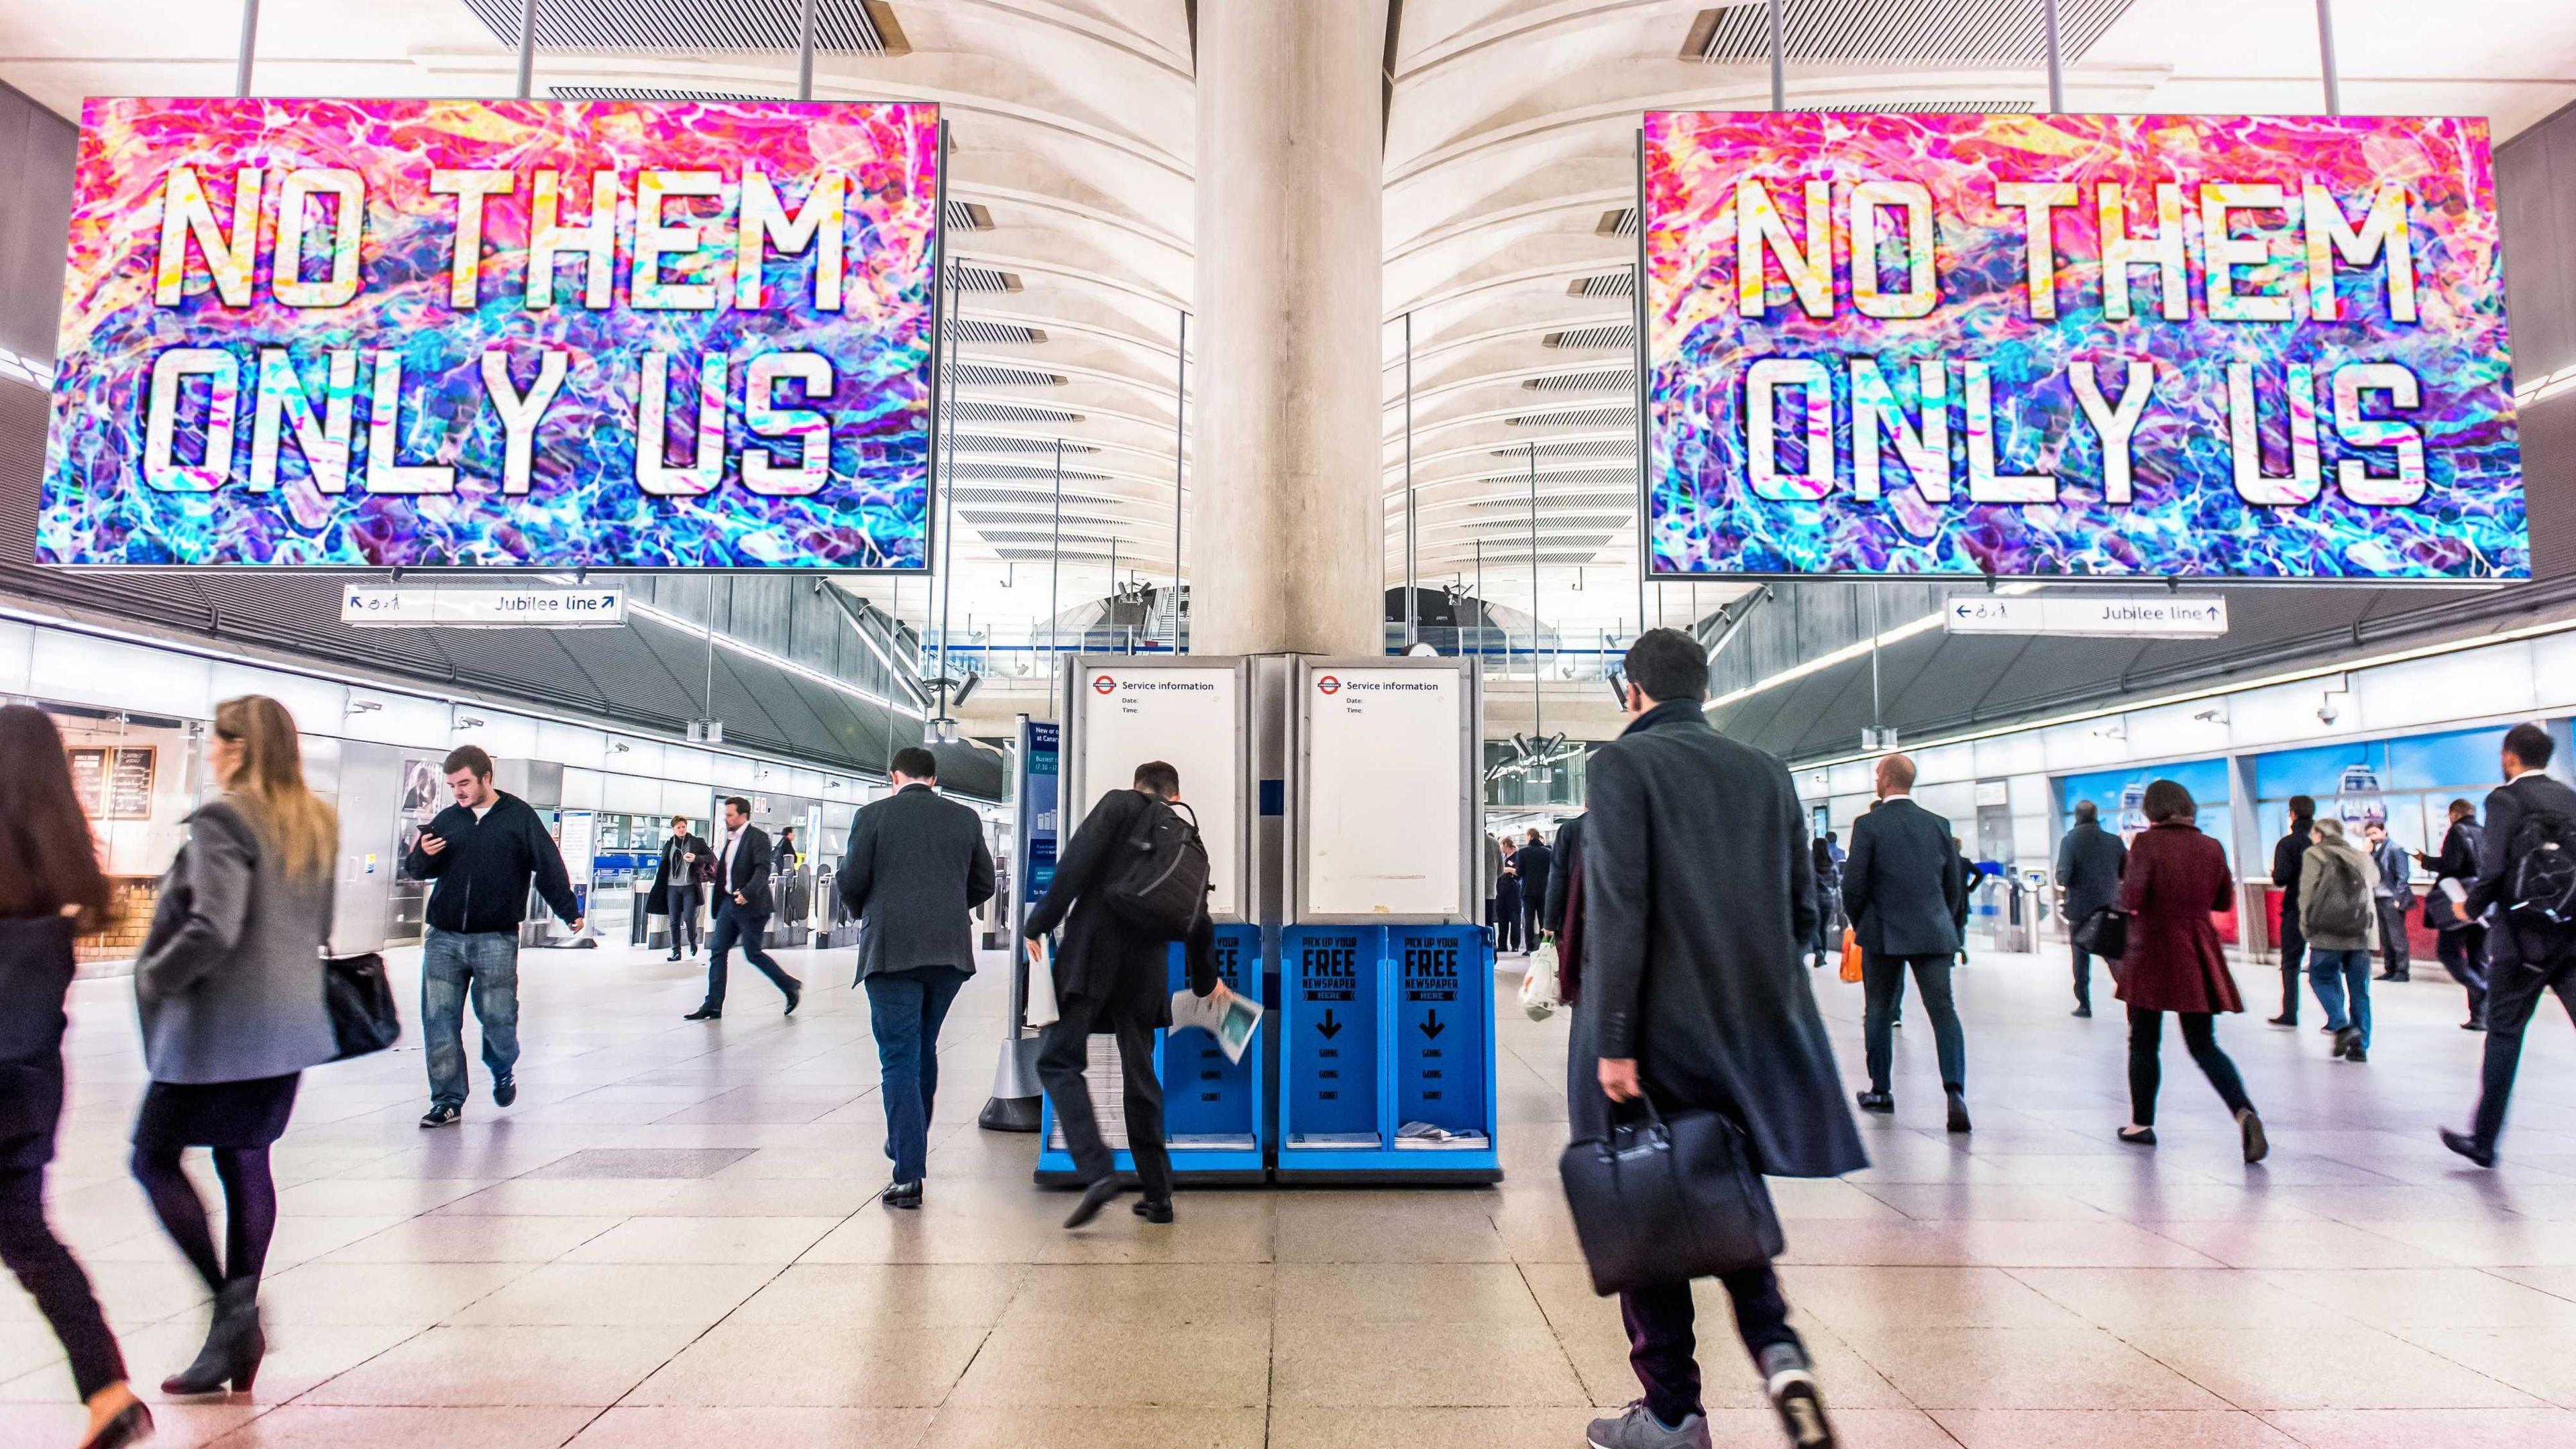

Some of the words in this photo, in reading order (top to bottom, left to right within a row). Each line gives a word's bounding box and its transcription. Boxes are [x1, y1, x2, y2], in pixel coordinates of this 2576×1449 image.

[154, 167, 366, 308] NO
[430, 169, 846, 310] THEM
[1736, 180, 1937, 318] NO
[1995, 182, 2416, 321] THEM
[143, 347, 569, 494] ONLY
[635, 351, 833, 496] US
[1746, 358, 2154, 504] ONLY
[2226, 362, 2426, 506] US
[495, 596, 558, 611] Jubilee
[566, 596, 597, 610] line
[2102, 606, 2164, 620] Jubilee
[2171, 606, 2202, 620] line
[1122, 682, 1156, 690] Service
[1159, 682, 1214, 691] information
[1346, 682, 1381, 690] Service
[1383, 682, 1438, 691] information
[1303, 937, 1320, 947] PICK
[1322, 937, 1333, 947] UP
[1335, 937, 1356, 947] YOUR
[1405, 937, 1422, 947] PICK
[1424, 938, 1435, 947] UP
[1437, 937, 1458, 947] YOUR
[1303, 949, 1356, 977] FREE
[1405, 949, 1458, 977] FREE
[1303, 978, 1356, 988] NEWSPAPER
[1405, 978, 1458, 988] NEWSPAPER
